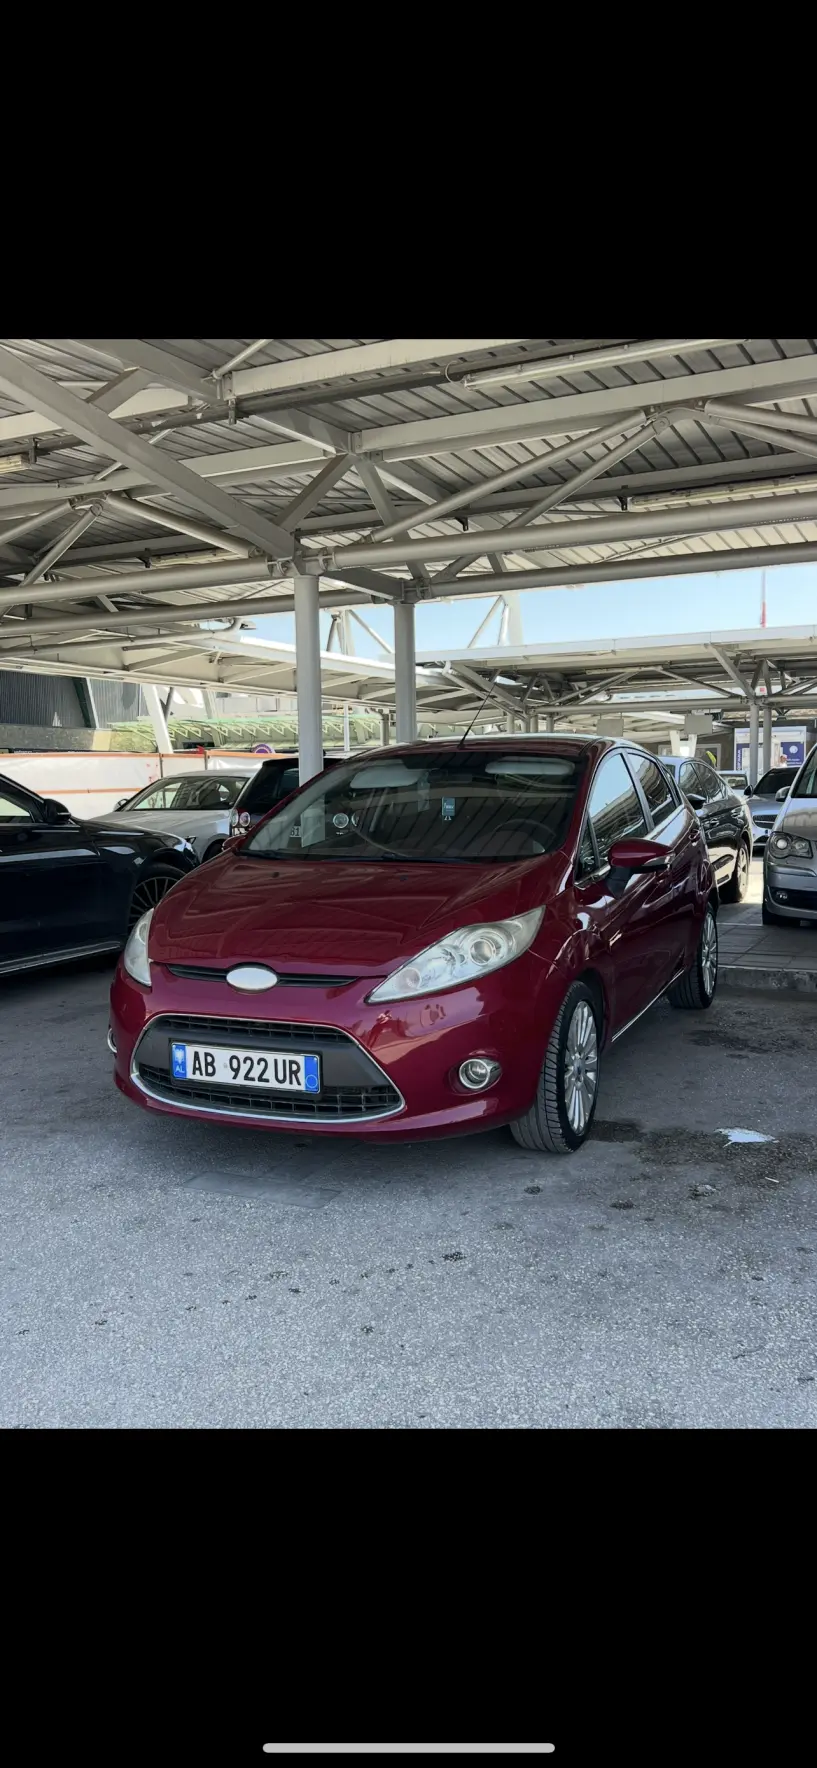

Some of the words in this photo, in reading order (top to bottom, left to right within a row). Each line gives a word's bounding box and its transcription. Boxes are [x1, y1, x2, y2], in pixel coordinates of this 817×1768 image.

[192, 1051, 216, 1077] AB
[229, 1055, 270, 1083] 922
[274, 1058, 302, 1085] UR
